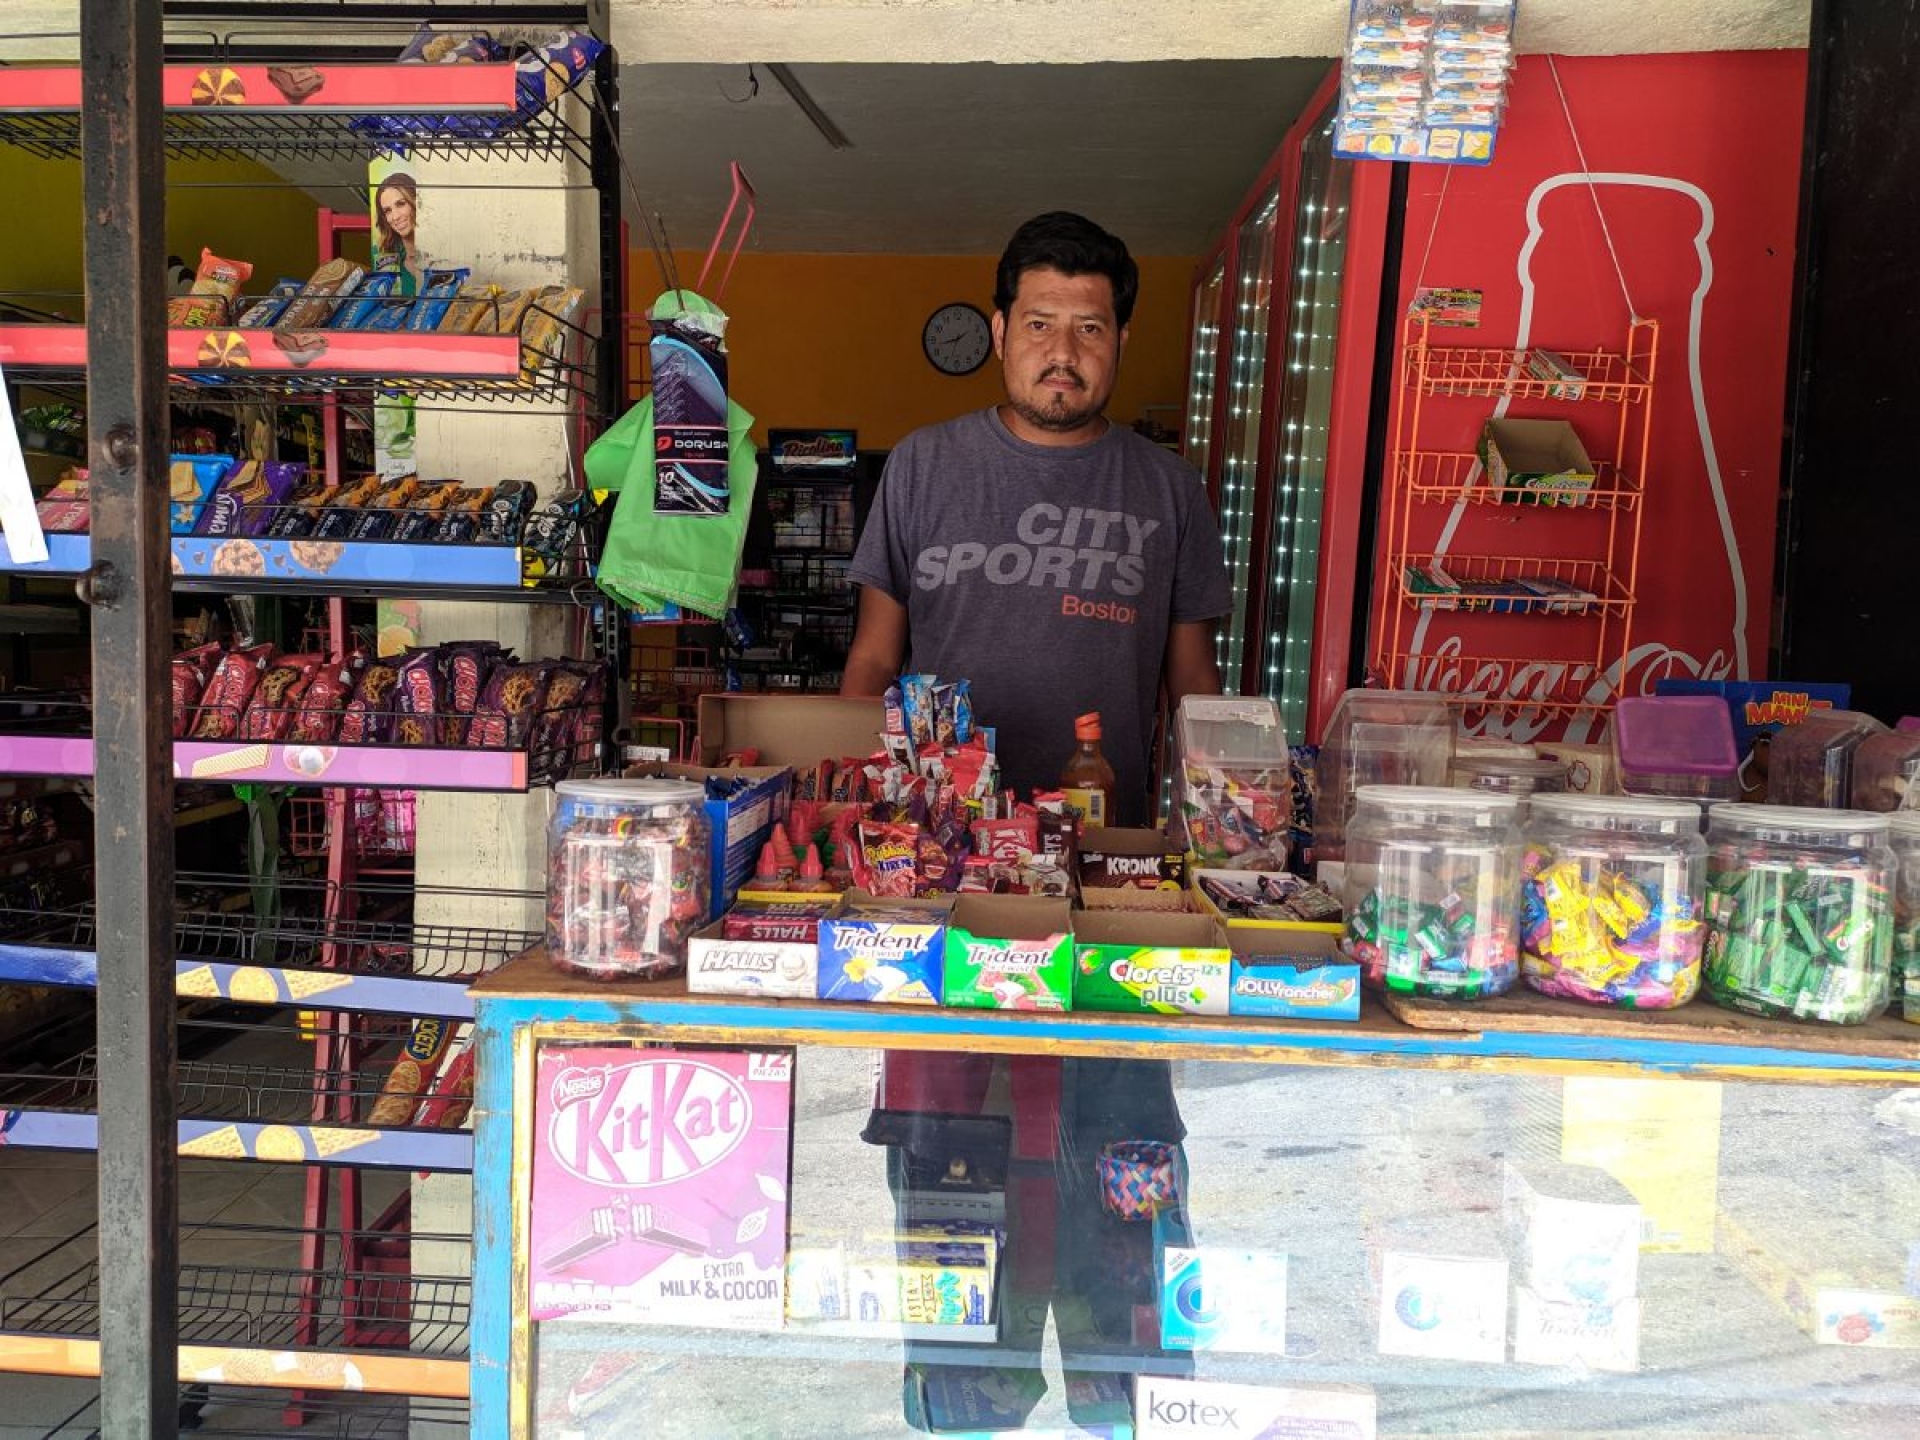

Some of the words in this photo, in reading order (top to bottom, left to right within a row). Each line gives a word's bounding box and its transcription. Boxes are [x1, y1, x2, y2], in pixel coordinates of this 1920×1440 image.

[1017, 503, 1160, 555] CITY
[916, 542, 1145, 596] SPORTS
[1107, 857, 1161, 876] KRONK
[752, 925, 808, 940] HALLS
[838, 929, 924, 950] Trident
[700, 950, 777, 974] HALLS
[970, 946, 1050, 966] Trident
[1110, 959, 1195, 985] Clorets
[703, 1262, 745, 1279] EXTRA
[660, 1280, 701, 1297] MILK
[704, 1281, 719, 1300] &
[722, 1280, 778, 1301] COCOA
[1149, 1390, 1240, 1430] kotex
